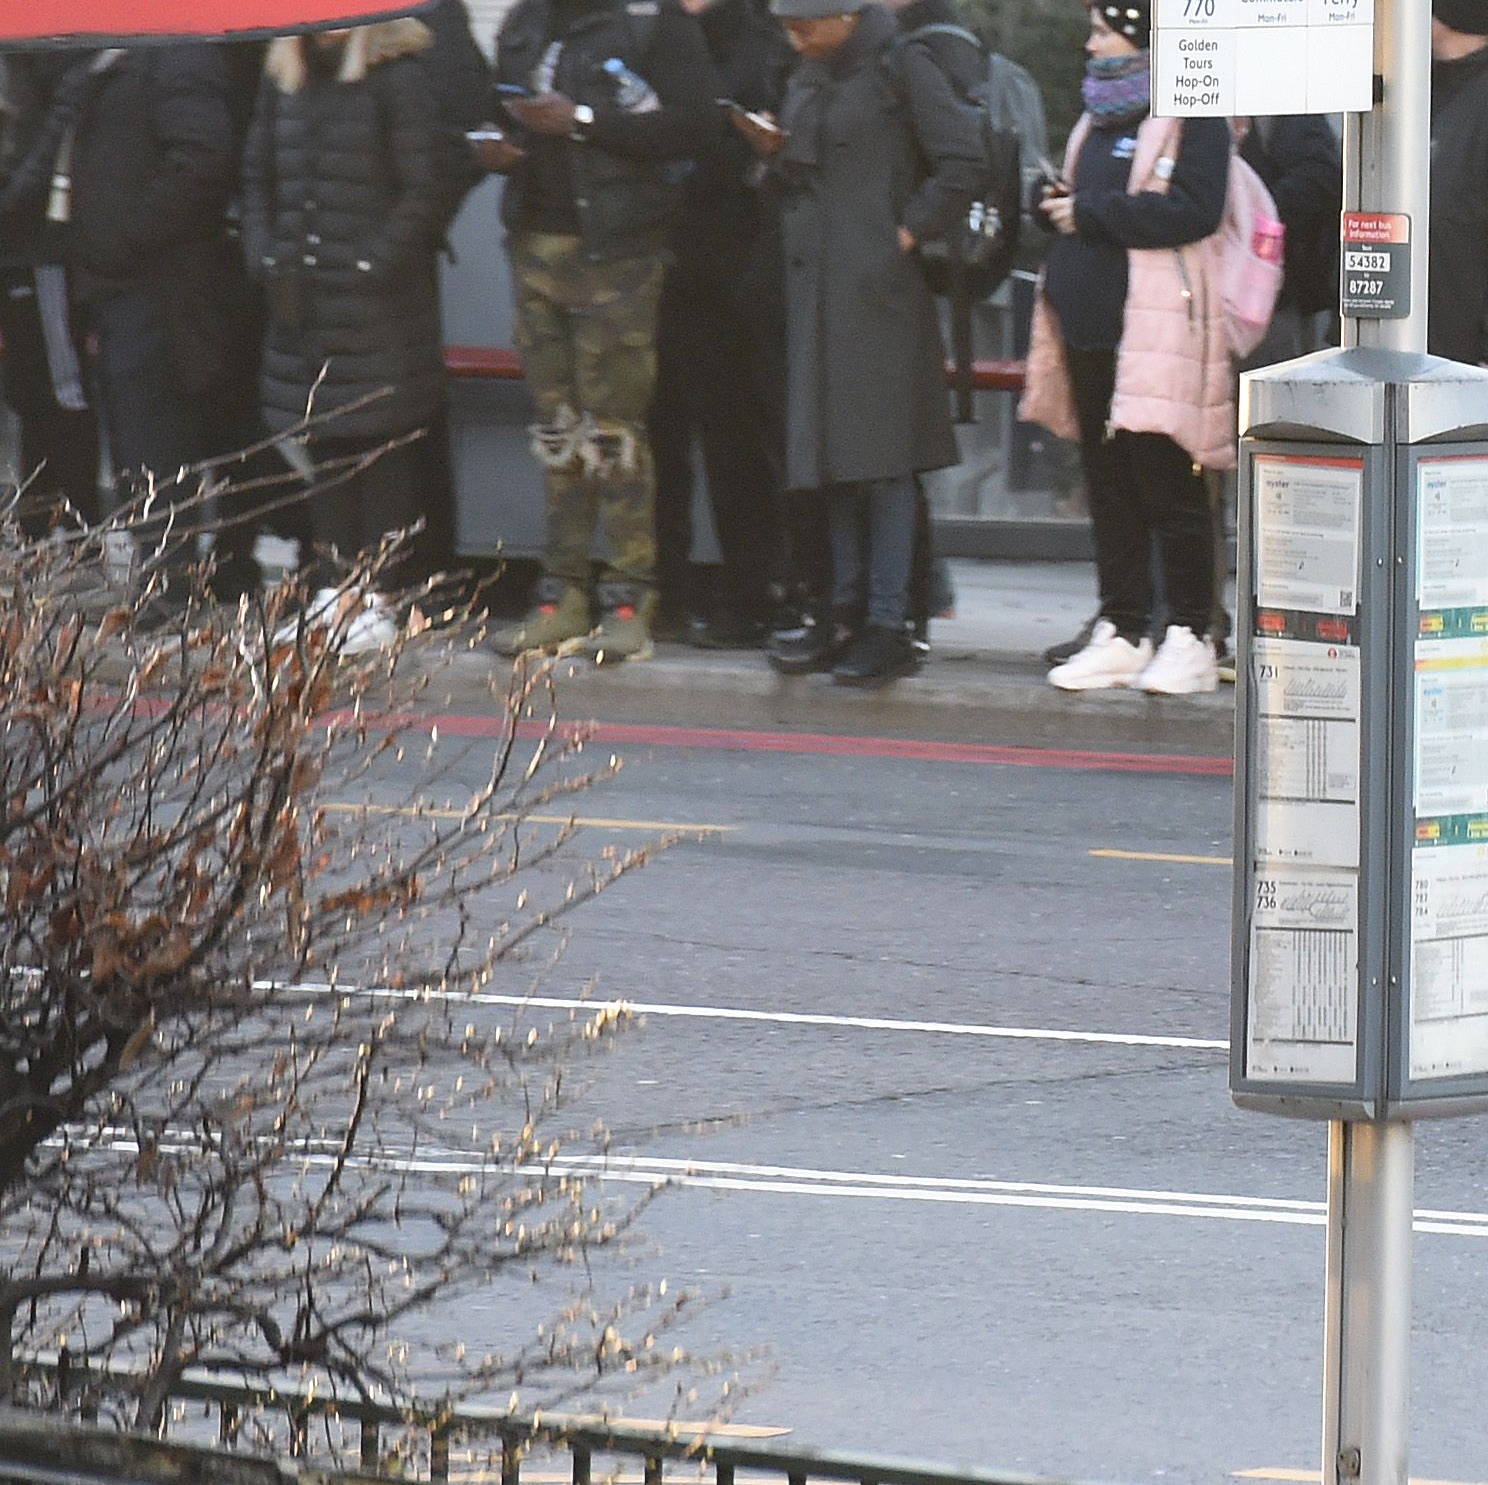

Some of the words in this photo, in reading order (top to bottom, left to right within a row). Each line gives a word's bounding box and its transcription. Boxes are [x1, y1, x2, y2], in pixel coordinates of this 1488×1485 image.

[1257, 13, 1287, 23] Mon-Fri
[1328, 11, 1356, 22] Mon-Fri
[1179, 39, 1218, 52] Golden
[1183, 57, 1213, 69] Tours
[1176, 75, 1219, 90] Hop-On
[1174, 92, 1220, 108] Hop-Off
[1361, 221, 1377, 229] next
[1378, 221, 1392, 229] bus
[1349, 255, 1386, 269] 54382
[1349, 280, 1383, 295] 87287
[1260, 665, 1279, 679] 731
[1257, 880, 1277, 894] 735
[1257, 895, 1277, 909] 736
